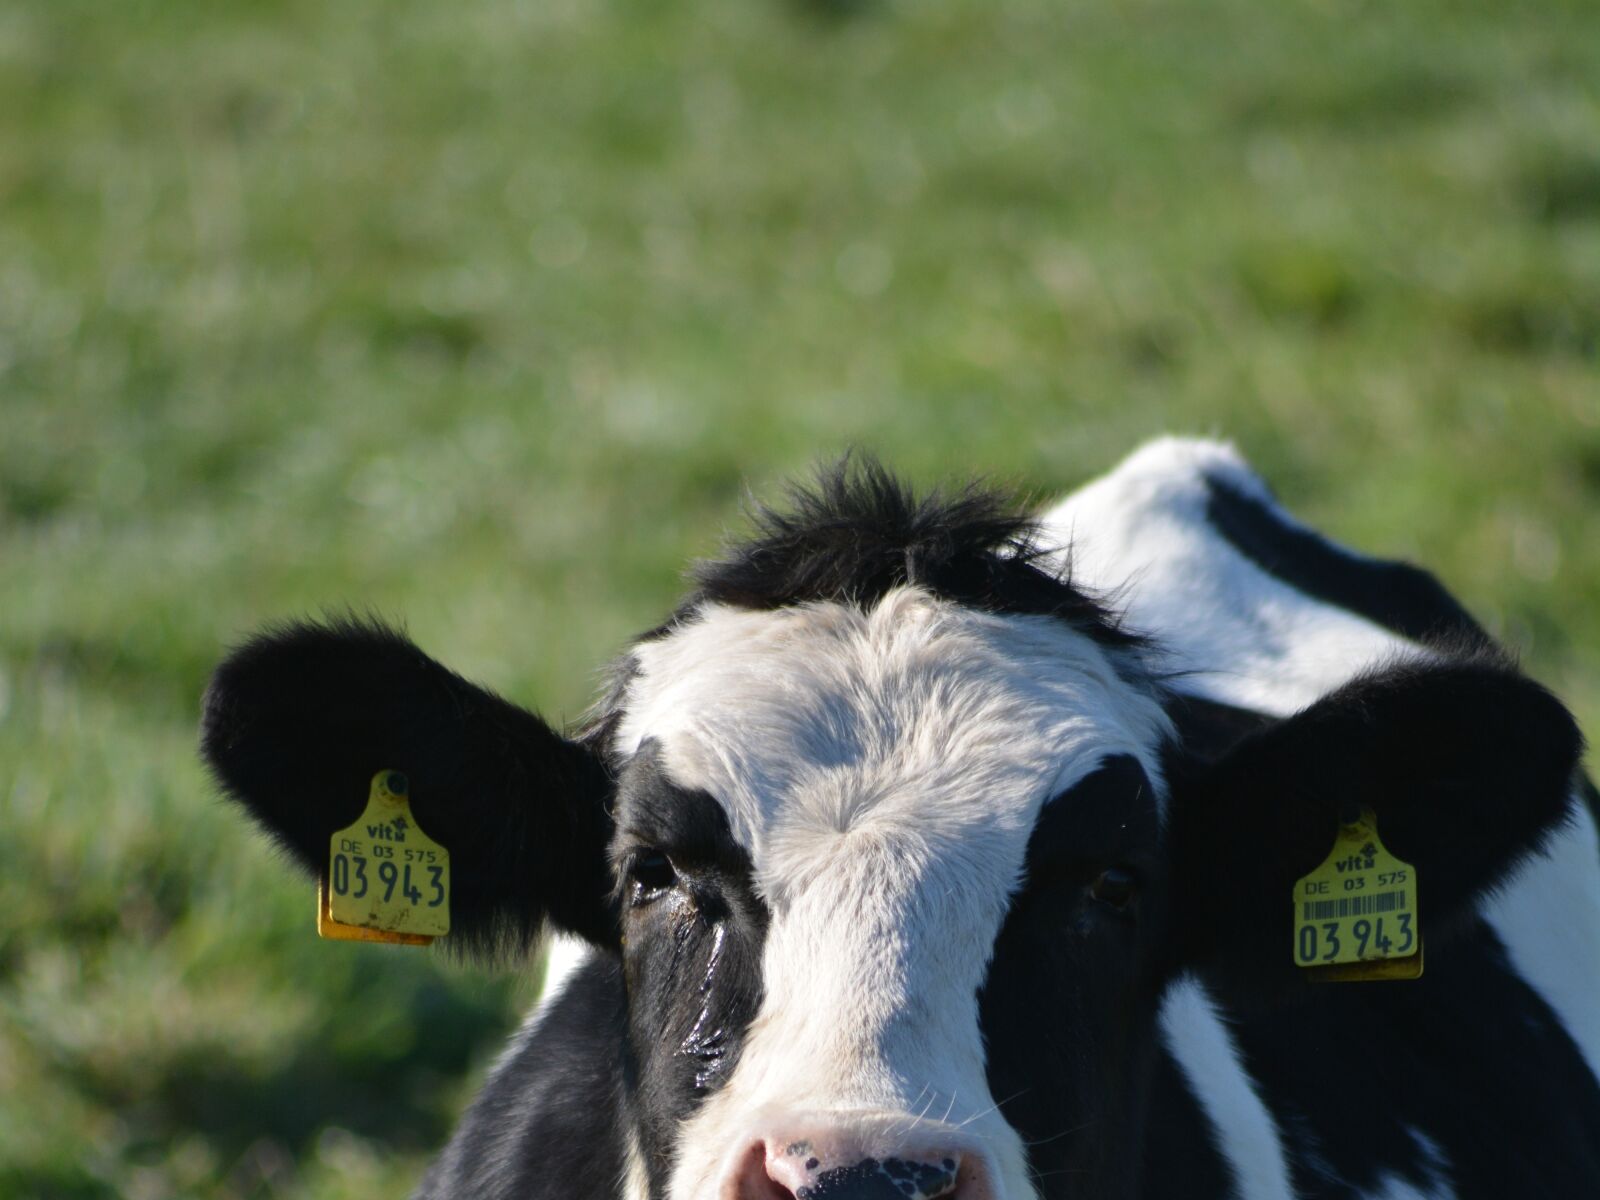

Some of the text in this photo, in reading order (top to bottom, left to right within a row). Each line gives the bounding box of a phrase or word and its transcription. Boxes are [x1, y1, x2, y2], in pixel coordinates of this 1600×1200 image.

[341, 839, 436, 863] DE 03 575
[334, 854, 445, 908] 03 943
[1305, 870, 1407, 895] DE 03 575
[1300, 913, 1413, 962] 03 943
